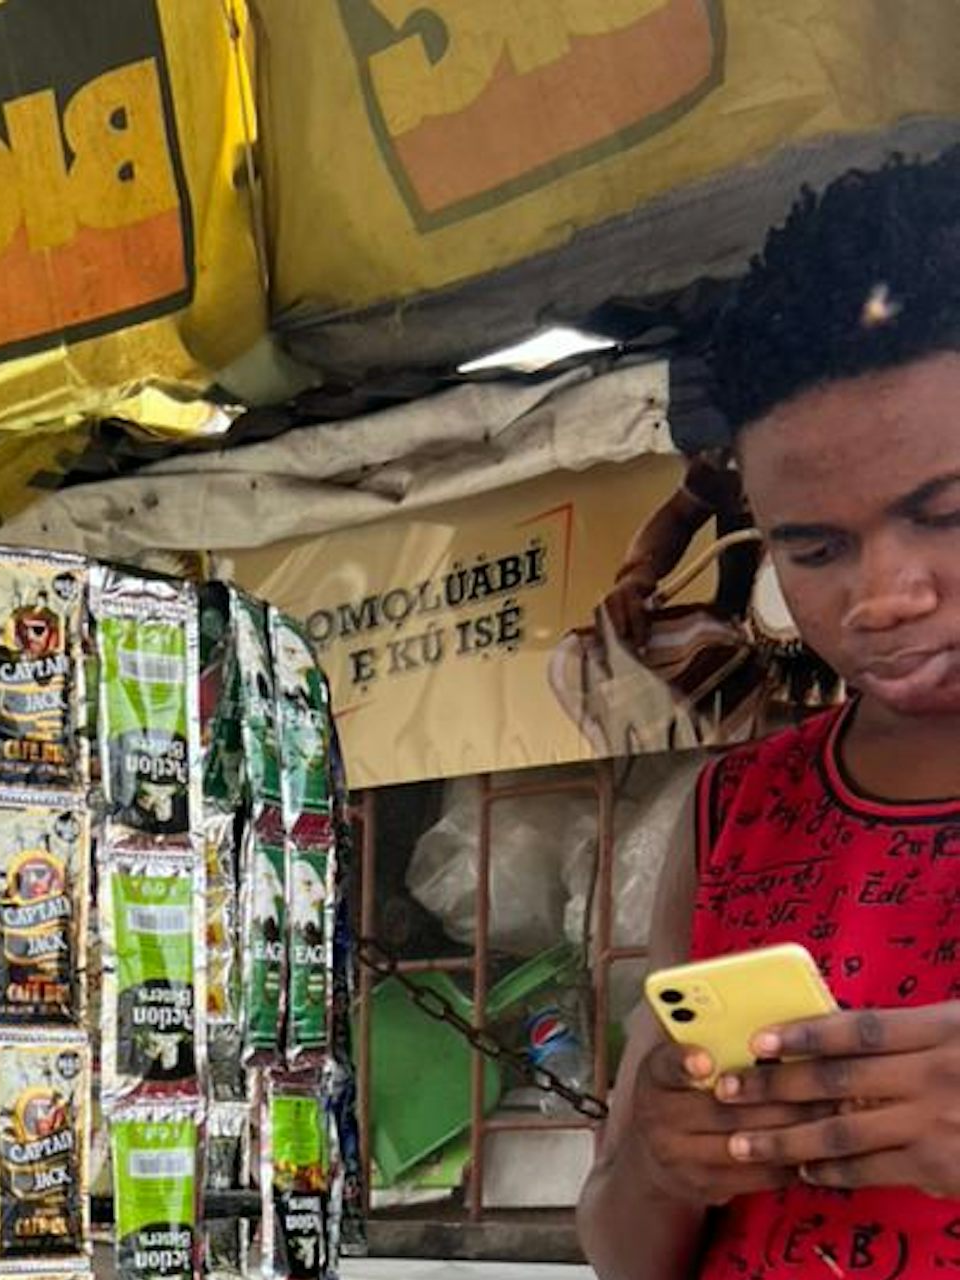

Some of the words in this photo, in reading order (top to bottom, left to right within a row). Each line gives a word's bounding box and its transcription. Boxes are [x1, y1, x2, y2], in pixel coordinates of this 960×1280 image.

[25, 690, 67, 712] JACK
[27, 933, 68, 956] JACK
[295, 945, 327, 964] EAG
[34, 1167, 73, 1192] JACK
[134, 1250, 191, 1273] ction
